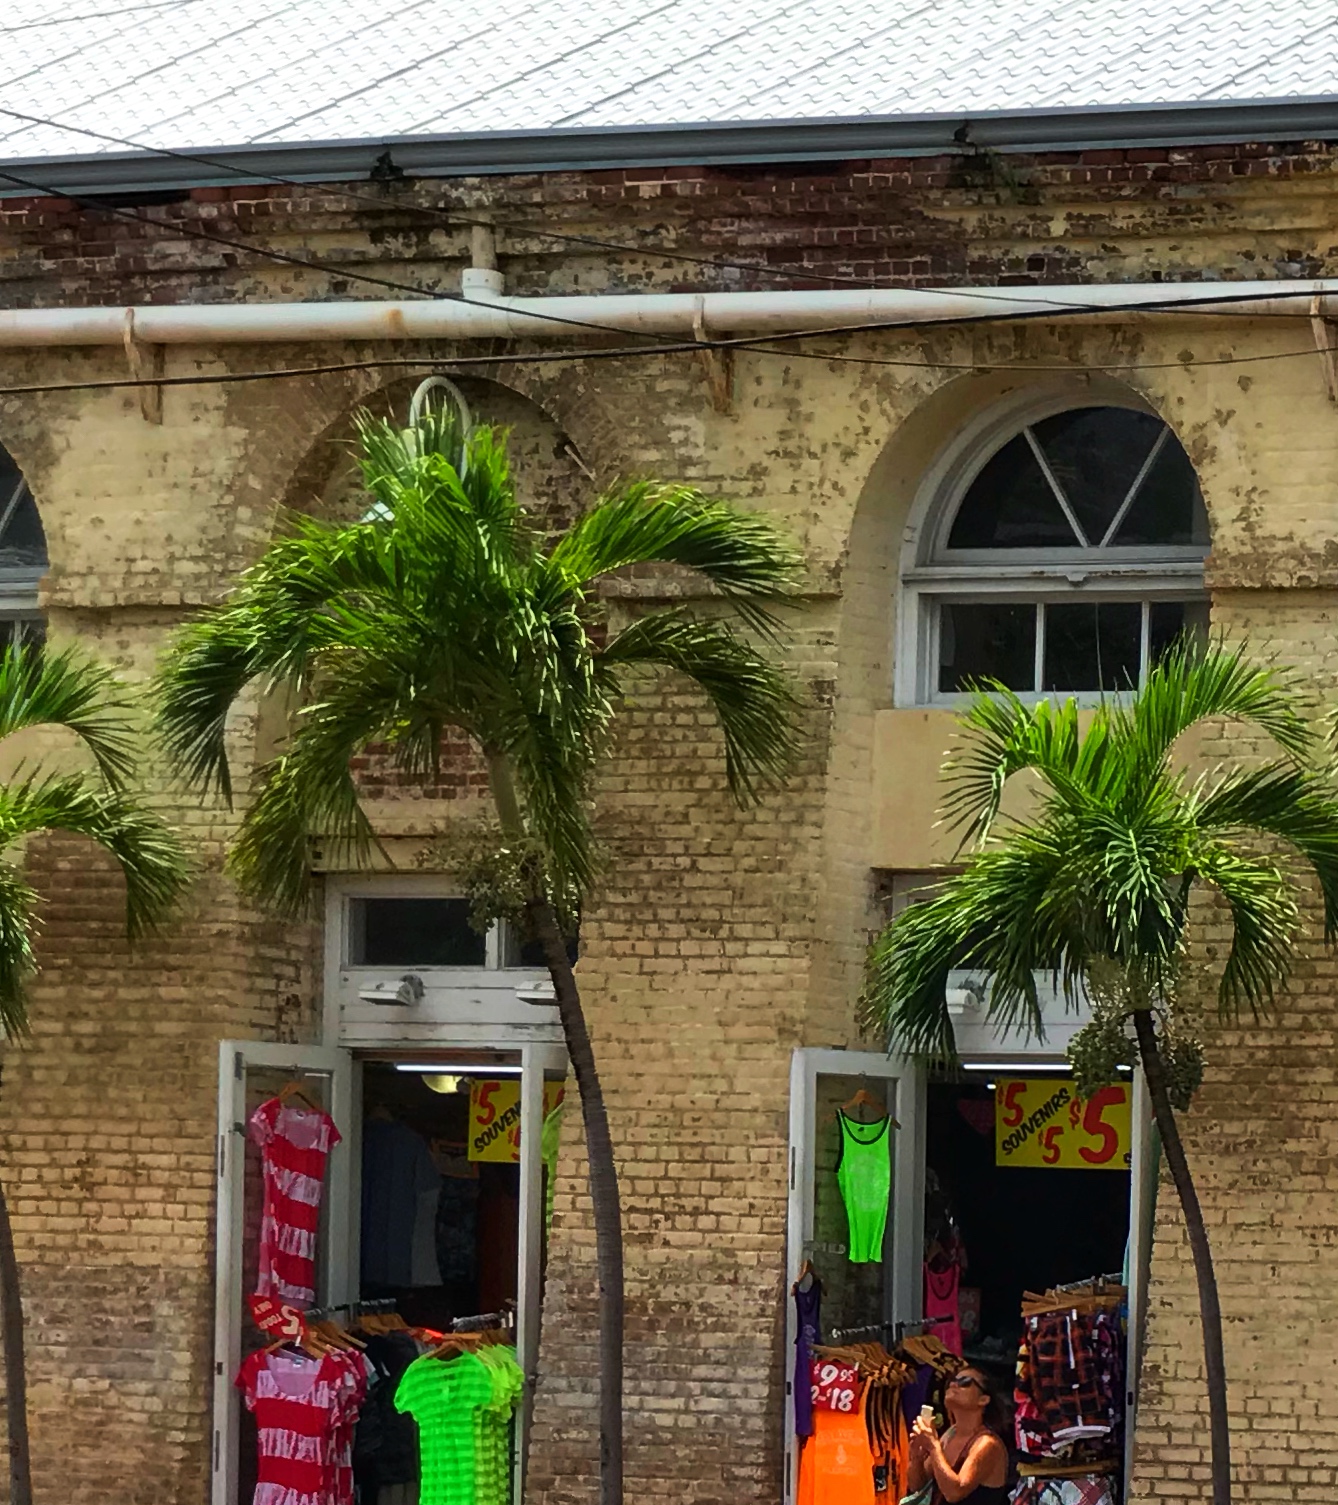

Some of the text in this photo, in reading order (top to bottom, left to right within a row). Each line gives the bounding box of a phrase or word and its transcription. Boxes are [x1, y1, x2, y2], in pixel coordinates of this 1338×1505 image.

[1002, 1087, 1071, 1156] SOUVENIRS
[1038, 1126, 1064, 1164] $5
[1069, 1086, 1126, 1164] $5
[826, 1388, 855, 1412] $18
